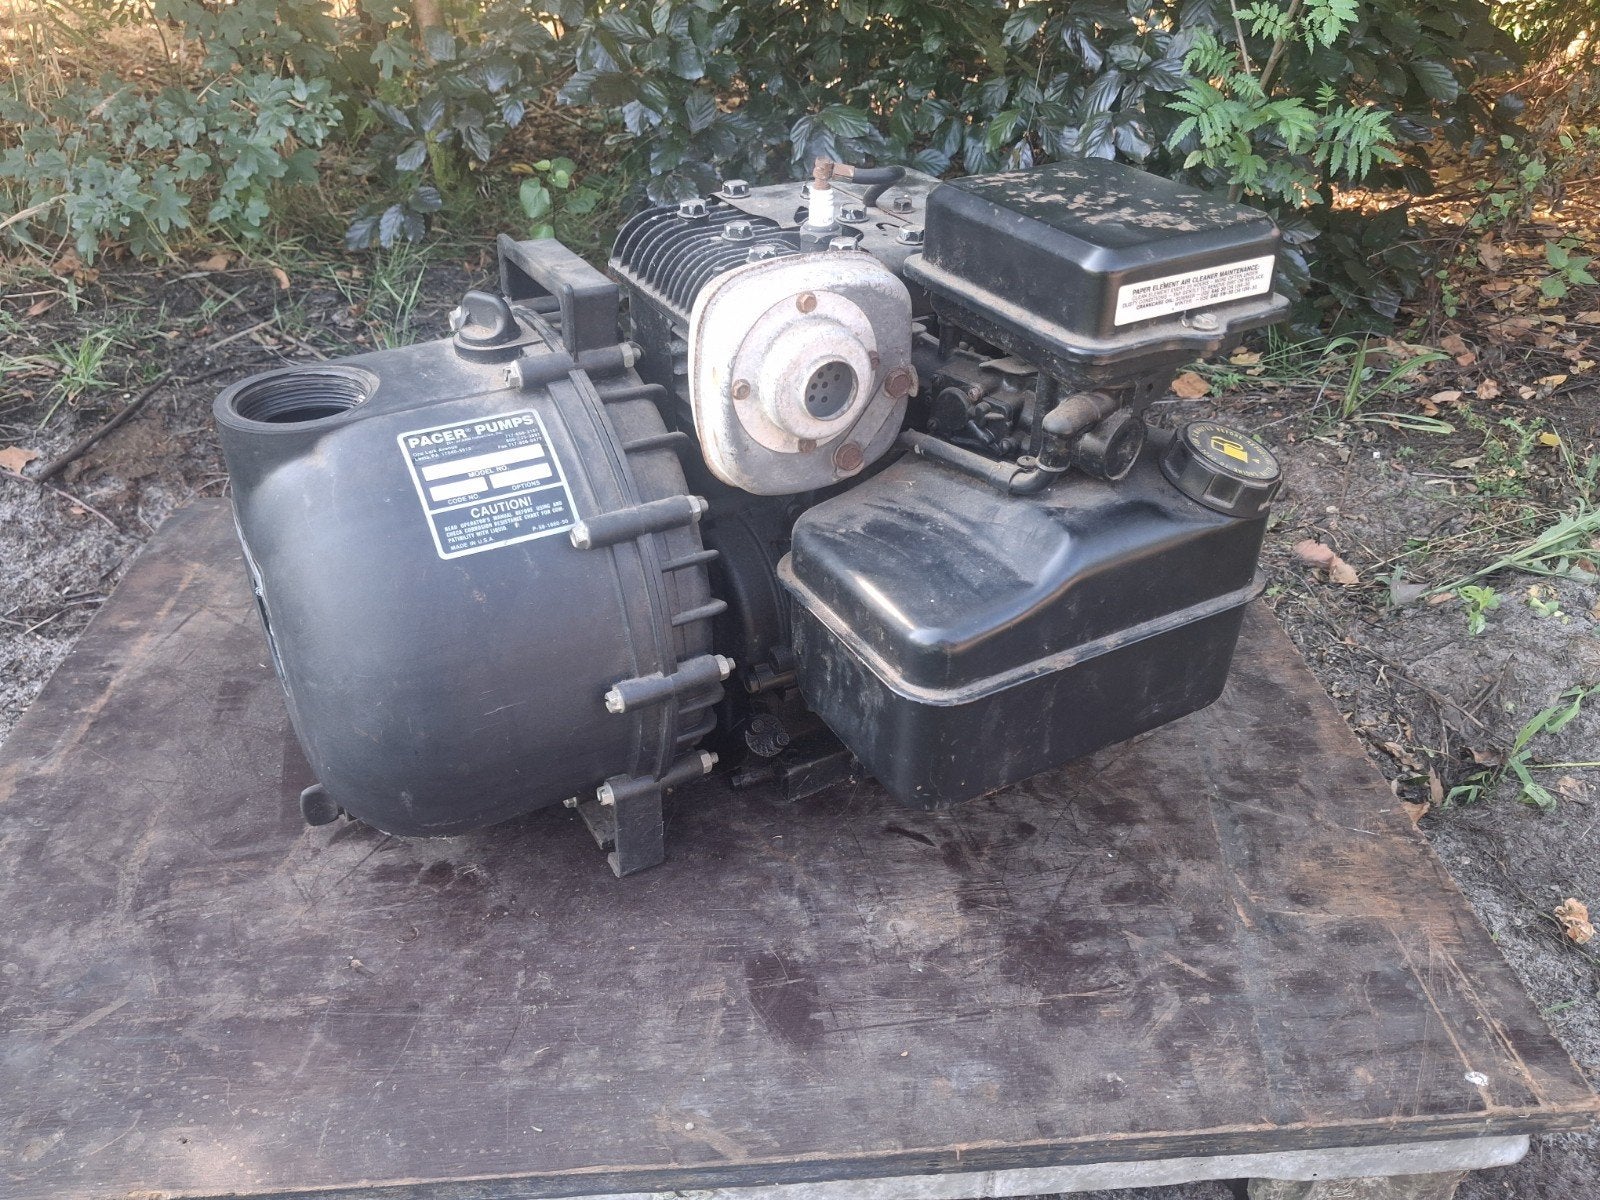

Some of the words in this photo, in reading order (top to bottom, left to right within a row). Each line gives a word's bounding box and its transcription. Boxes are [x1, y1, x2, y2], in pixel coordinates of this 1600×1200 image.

[1153, 281, 1178, 290] ELEMENT
[1193, 273, 1217, 282] CLEANER
[1220, 264, 1259, 276] MAINTENANCE:
[474, 416, 534, 434] PUMPS
[468, 468, 493, 477] MODEL
[512, 480, 540, 490] OPTIONS
[470, 497, 532, 518] CAUTION!
[465, 523, 492, 532] CORROSION
[494, 516, 522, 525] RESISTANCE
[448, 533, 474, 542] PATIBILITY
